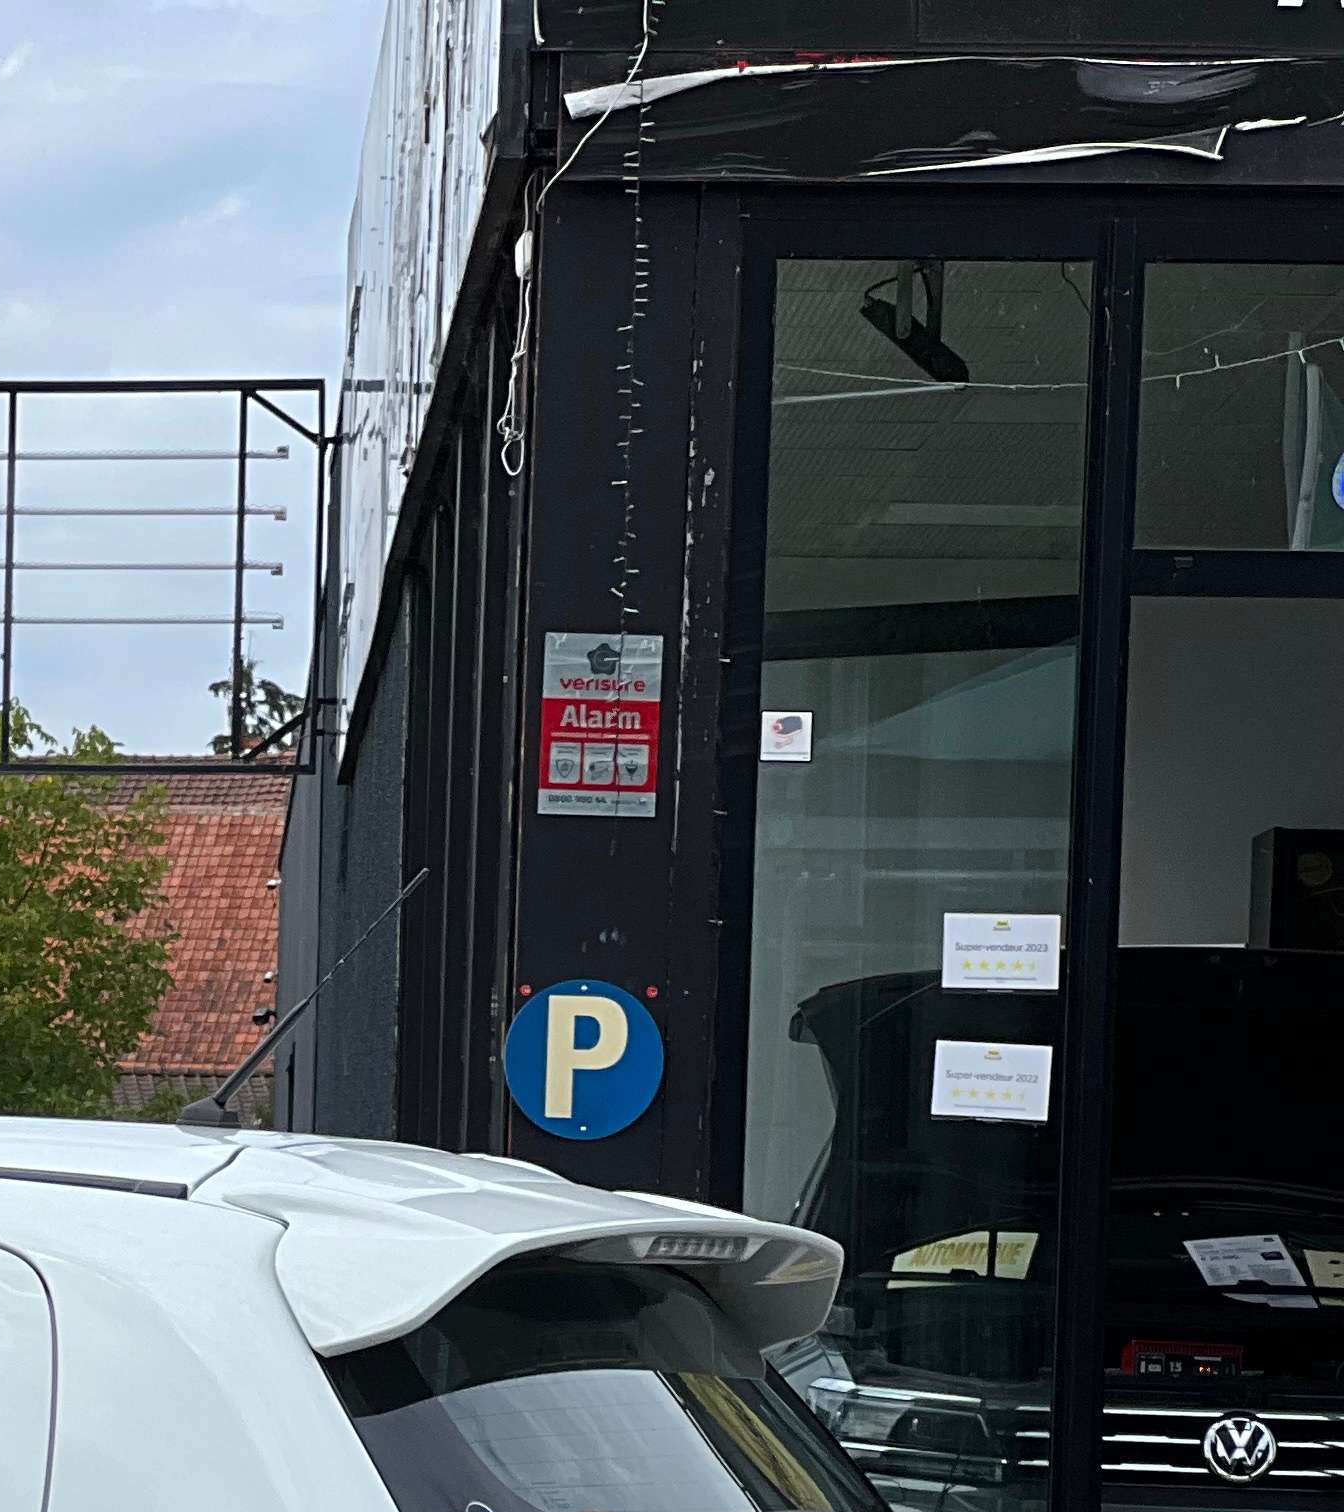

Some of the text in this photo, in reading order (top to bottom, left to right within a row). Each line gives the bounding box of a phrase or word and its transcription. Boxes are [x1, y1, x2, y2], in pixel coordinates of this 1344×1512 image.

[559, 676, 647, 693] verisure
[559, 703, 642, 730] Alarm
[955, 942, 1049, 953] Super-vendeur 2023
[544, 994, 629, 1119] P
